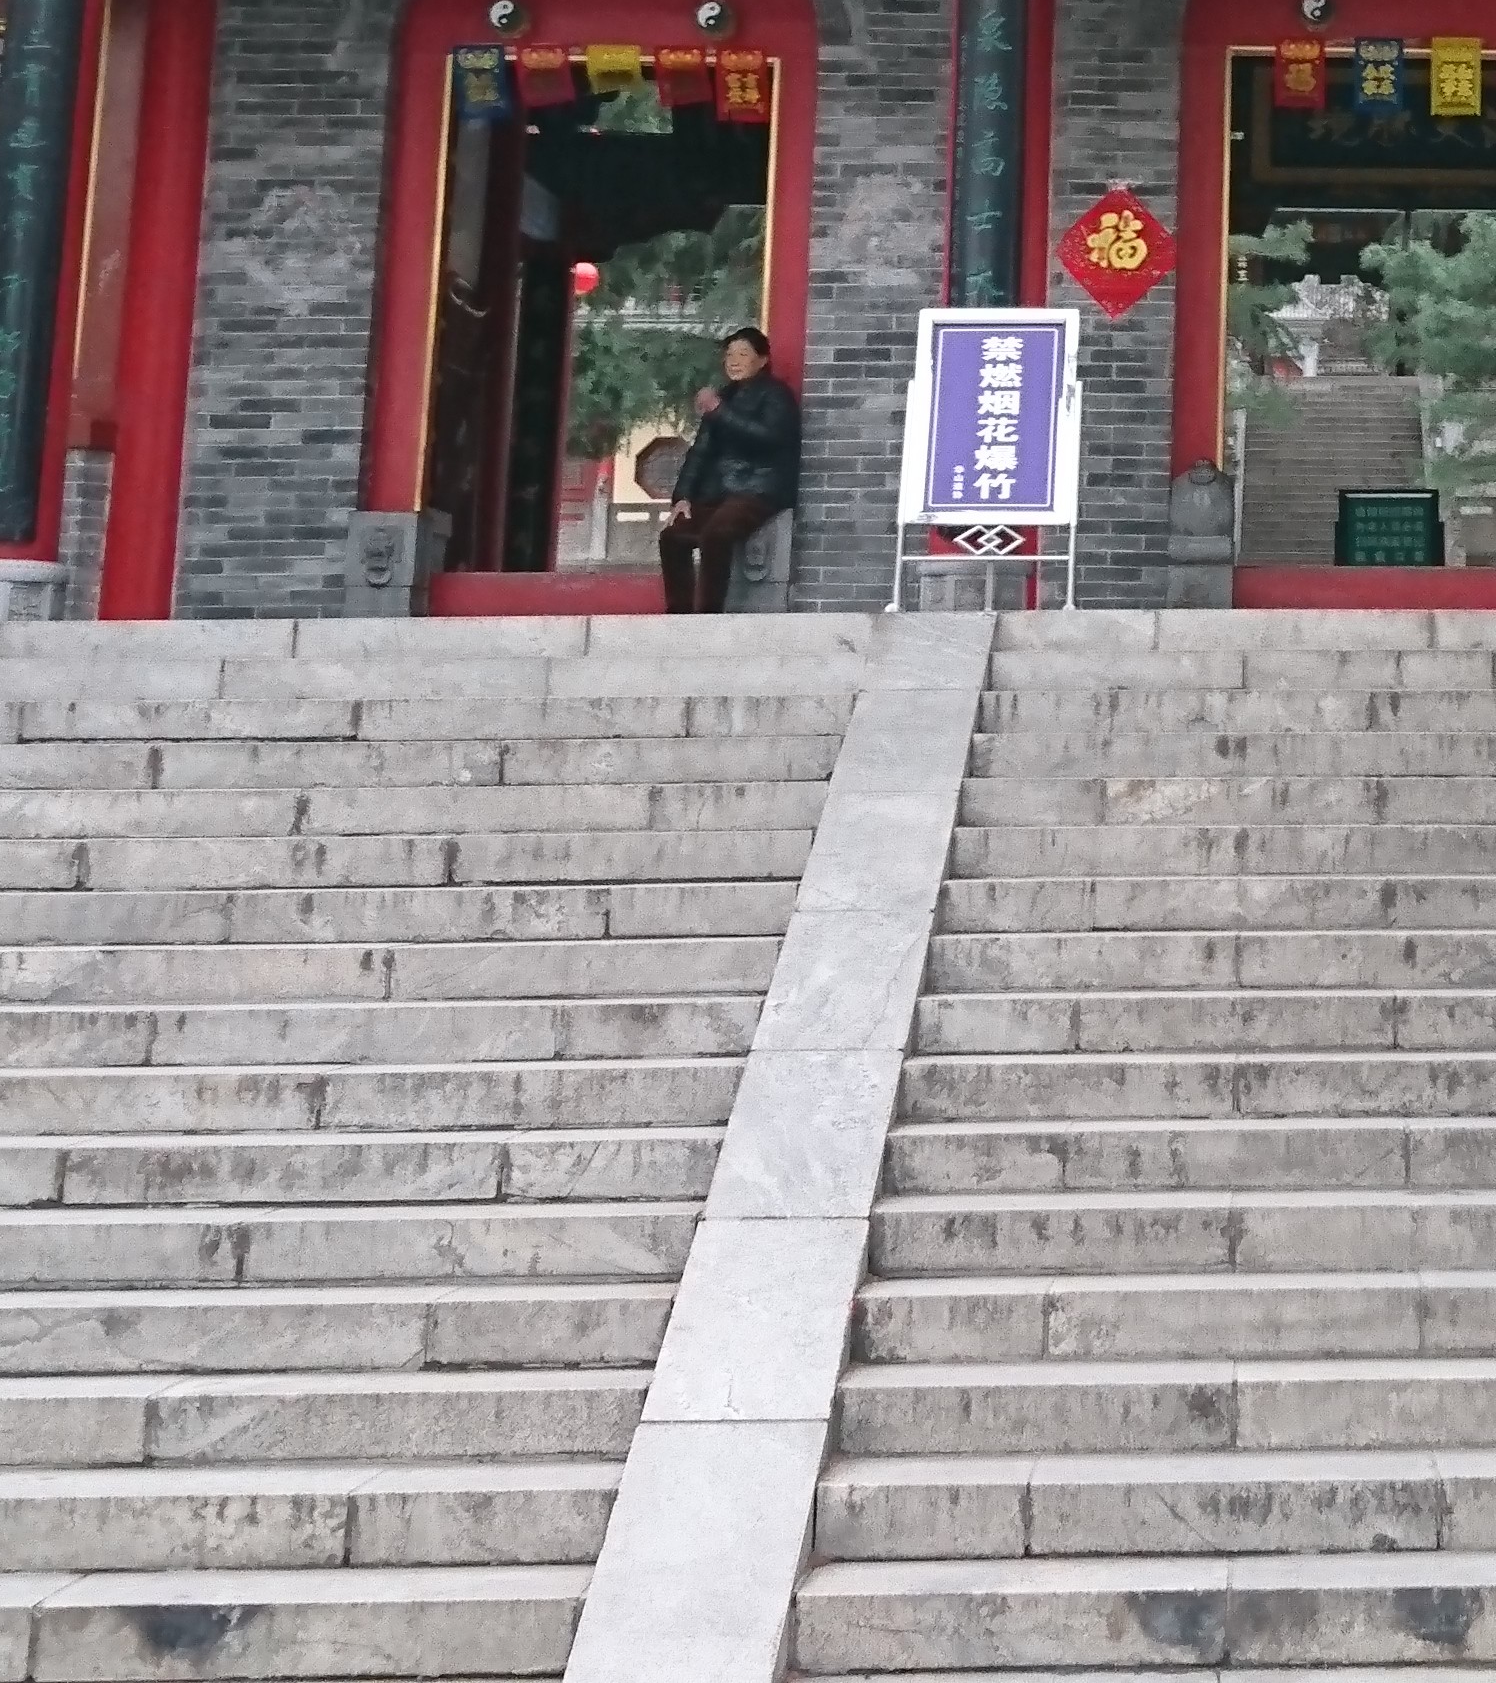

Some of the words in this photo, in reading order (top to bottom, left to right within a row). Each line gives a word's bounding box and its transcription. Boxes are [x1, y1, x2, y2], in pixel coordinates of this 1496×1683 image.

[1086, 209, 1148, 271] 福
[972, 336, 1024, 500] 禁燃烟花爆竹
